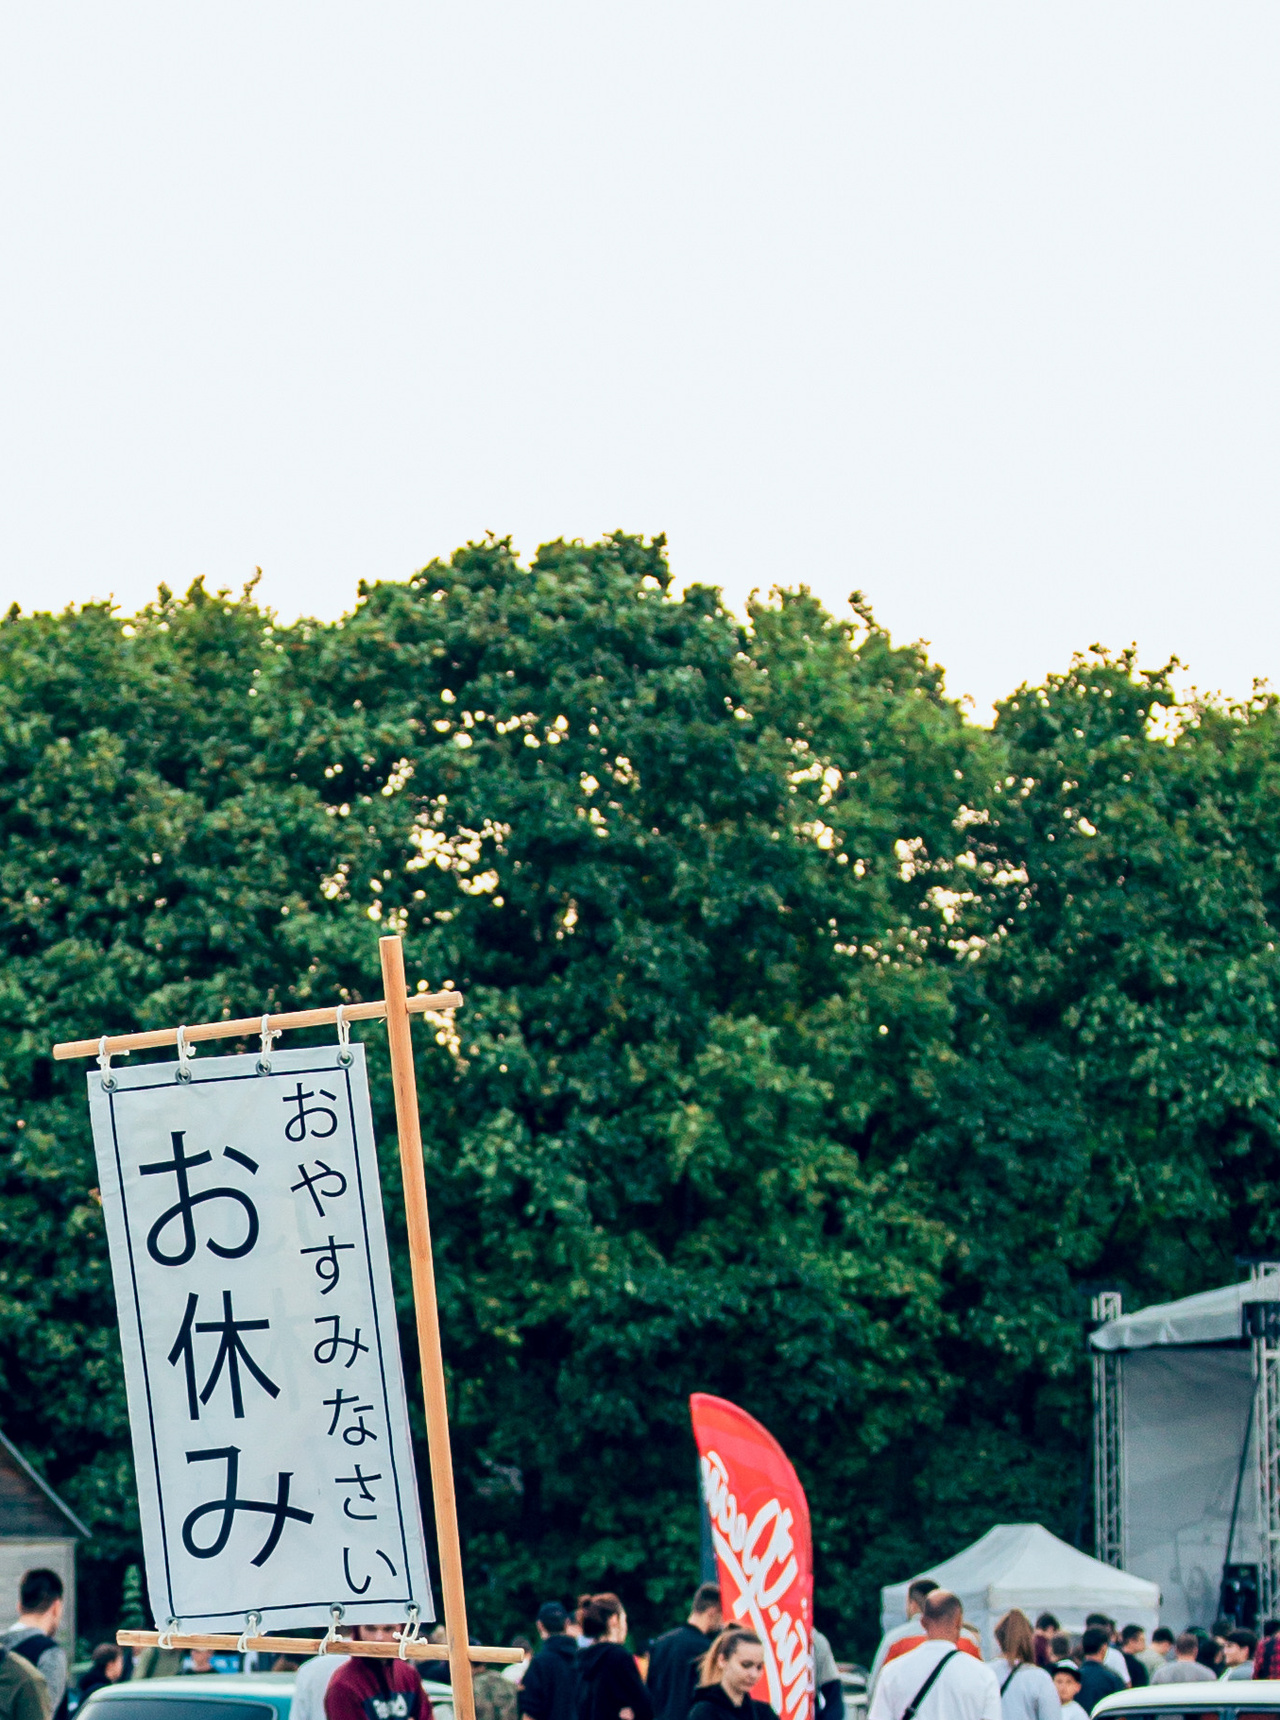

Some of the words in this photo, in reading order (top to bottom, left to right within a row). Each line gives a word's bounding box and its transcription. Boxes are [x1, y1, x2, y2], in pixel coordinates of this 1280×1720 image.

[138, 1129, 315, 1569] お休み
[280, 1080, 399, 1596] おやすみなさい
